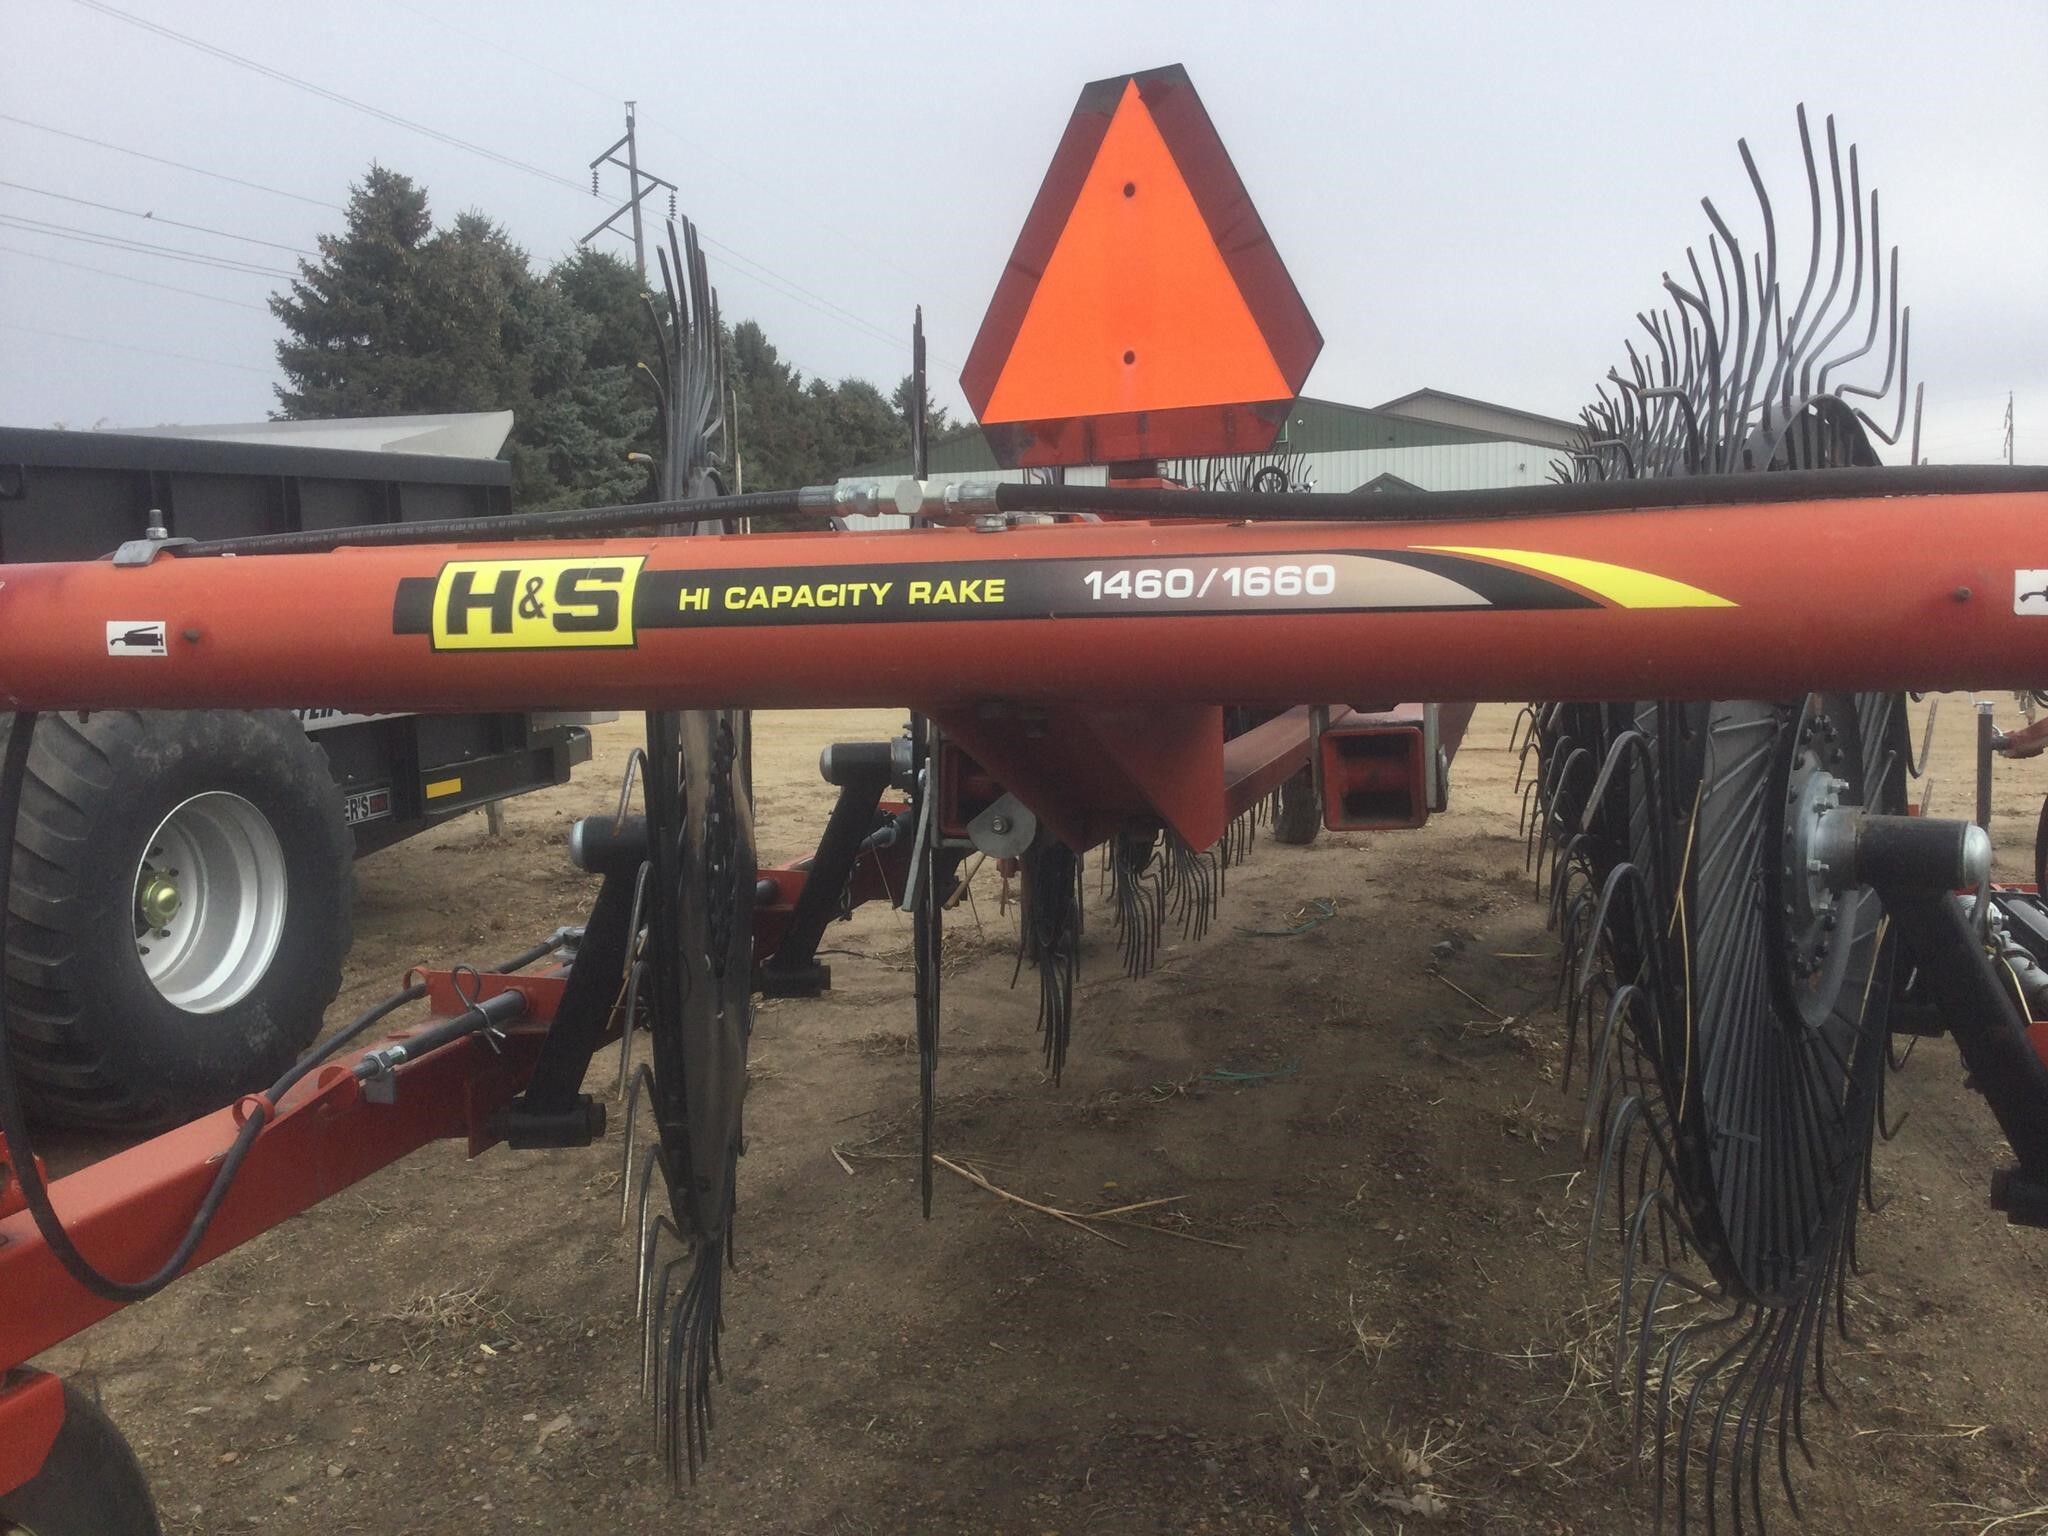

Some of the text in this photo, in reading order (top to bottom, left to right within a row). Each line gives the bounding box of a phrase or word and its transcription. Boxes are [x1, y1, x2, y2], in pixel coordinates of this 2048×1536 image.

[679, 579, 1006, 611] HI CAPACITY RAKE
[1083, 564, 1336, 600] 1460/1660
[446, 566, 625, 635] H&S
